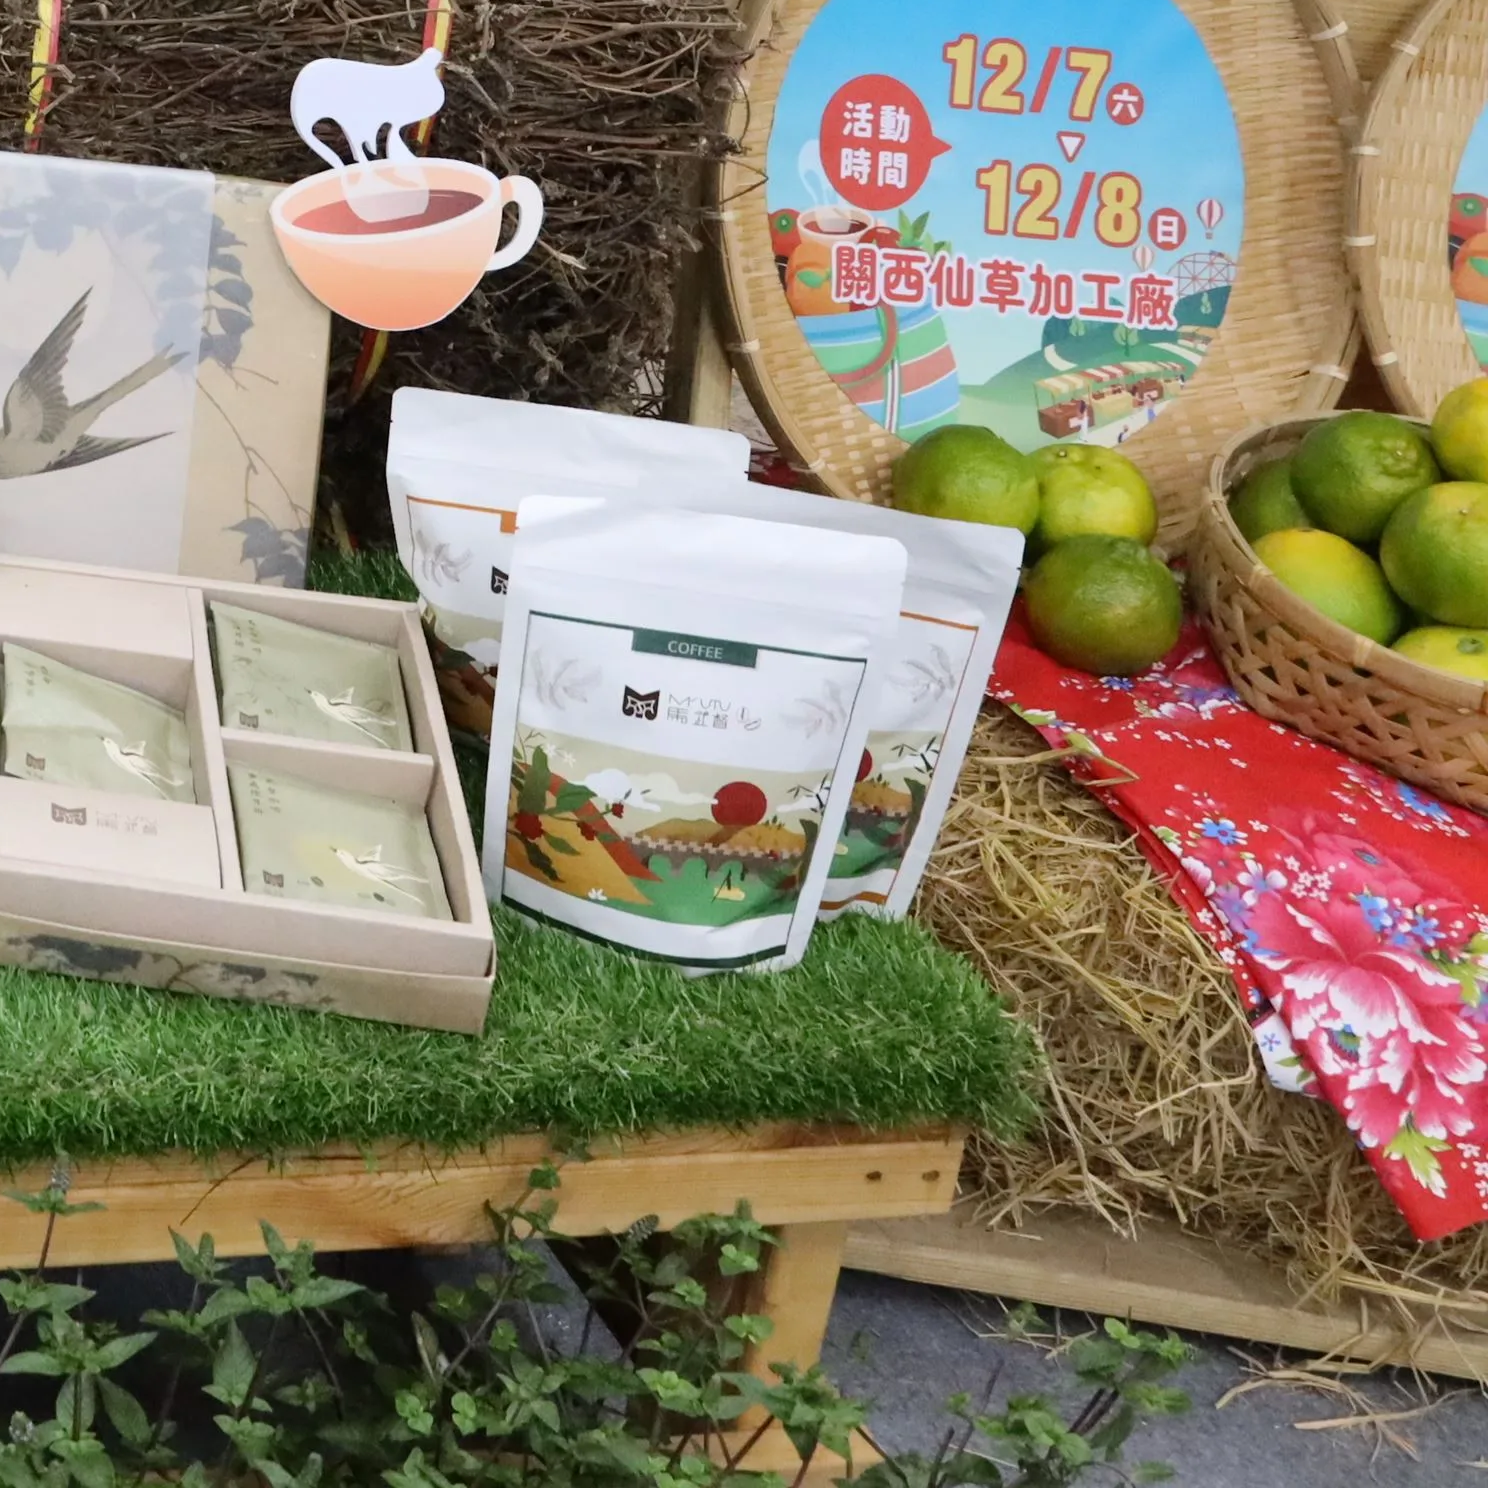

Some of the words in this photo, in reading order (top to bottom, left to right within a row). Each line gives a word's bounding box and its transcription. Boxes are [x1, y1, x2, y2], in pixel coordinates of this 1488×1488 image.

[942, 33, 1112, 123] 12/7
[1110, 87, 1140, 120] 六
[840, 100, 912, 143] 活動
[839, 146, 910, 190] 時間
[977, 160, 1142, 247] 12/8
[1155, 213, 1181, 244] 日
[831, 247, 1179, 330] 關西仙草加工廠
[667, 640, 724, 660] COFFEE
